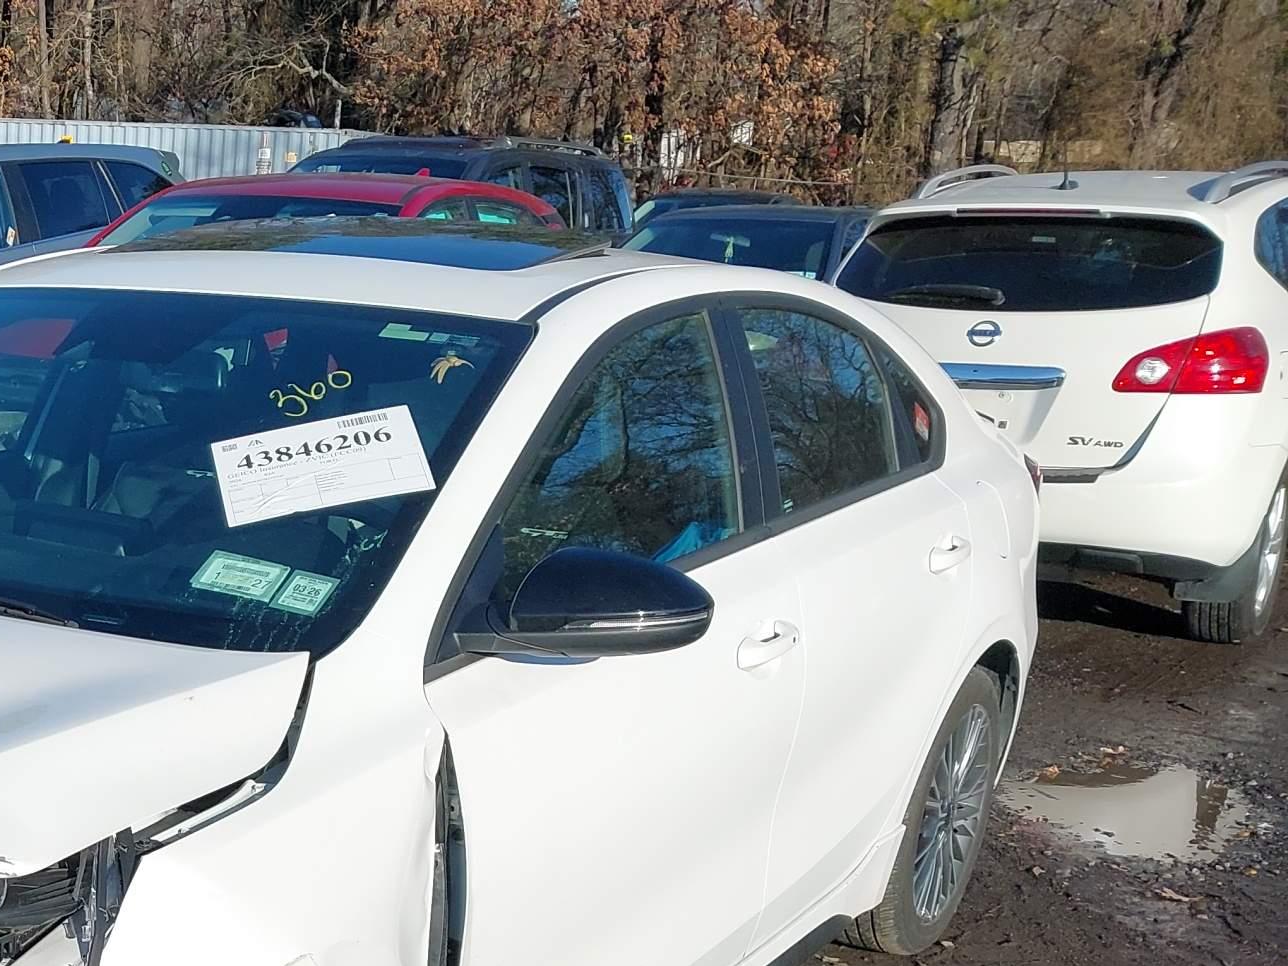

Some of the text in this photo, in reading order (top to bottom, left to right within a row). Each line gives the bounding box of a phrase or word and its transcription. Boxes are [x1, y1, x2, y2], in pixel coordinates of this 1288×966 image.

[269, 371, 352, 417] 360
[237, 426, 392, 469] 43846206
[1066, 436, 1124, 448] SV AWD
